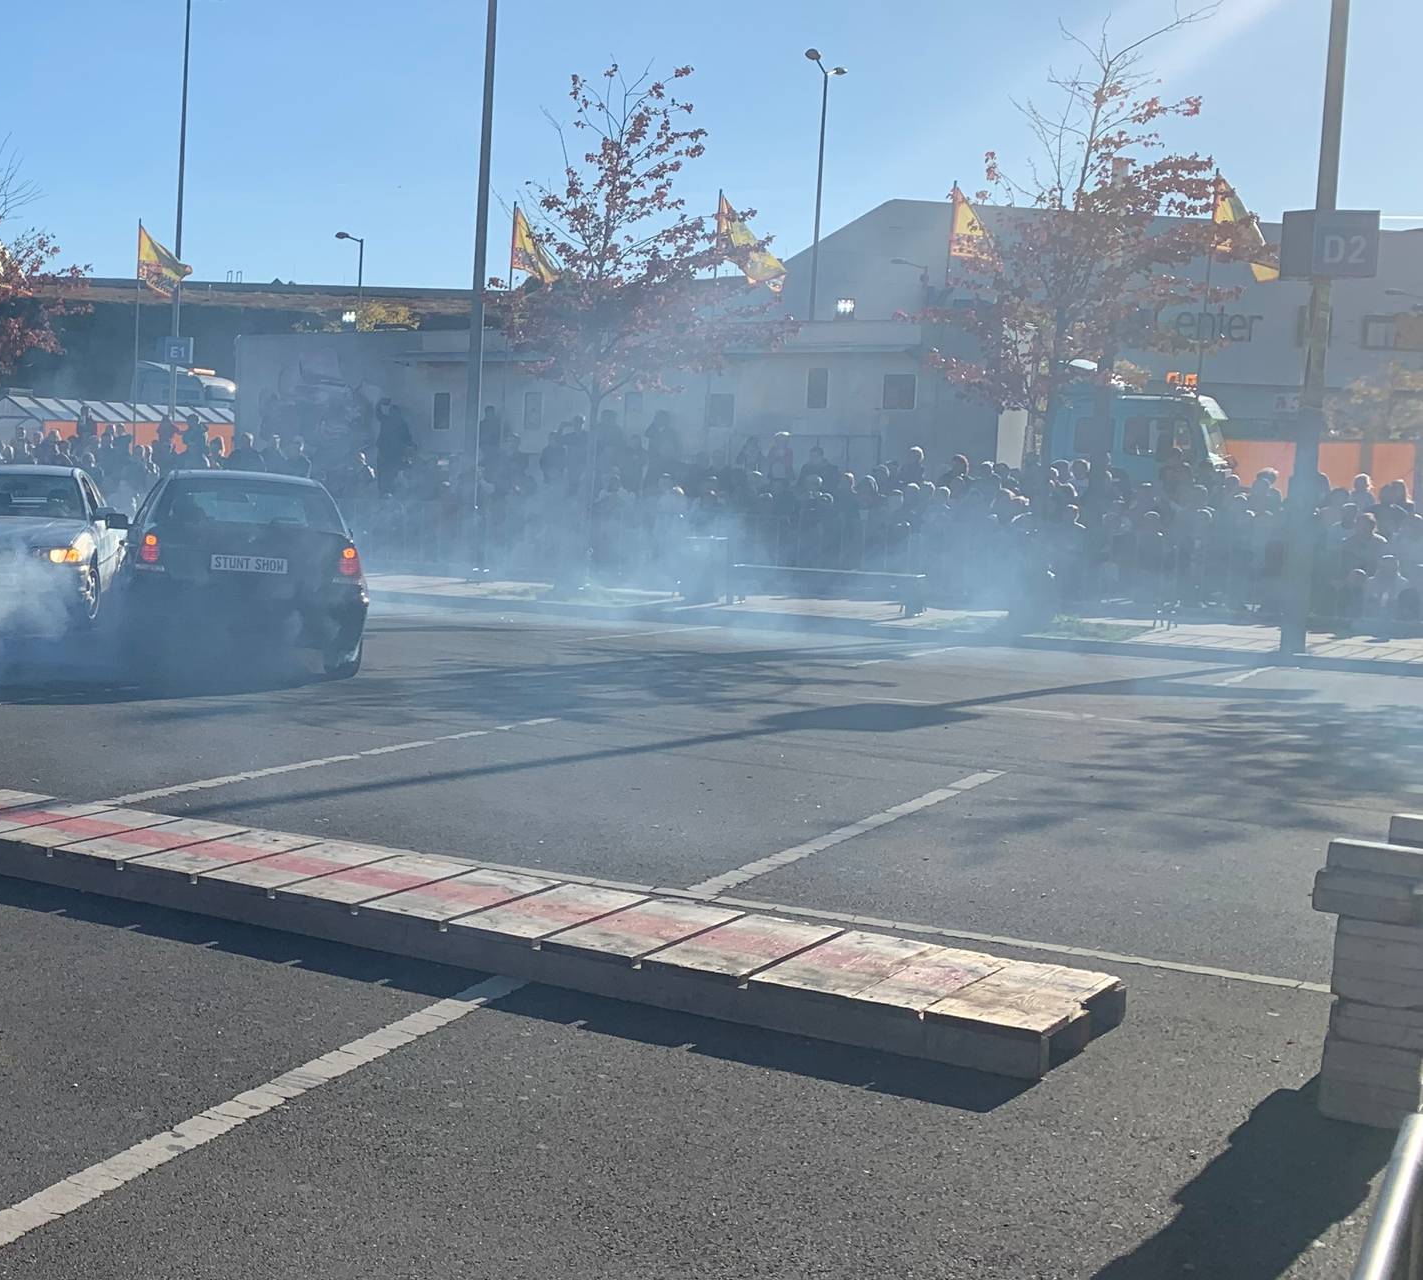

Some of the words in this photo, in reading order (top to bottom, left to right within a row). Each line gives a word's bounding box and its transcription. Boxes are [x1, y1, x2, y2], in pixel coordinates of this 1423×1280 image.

[1323, 235, 1366, 263] D2
[170, 346, 185, 358] E1
[215, 556, 251, 570] STUNT
[255, 558, 284, 572] SHOW
